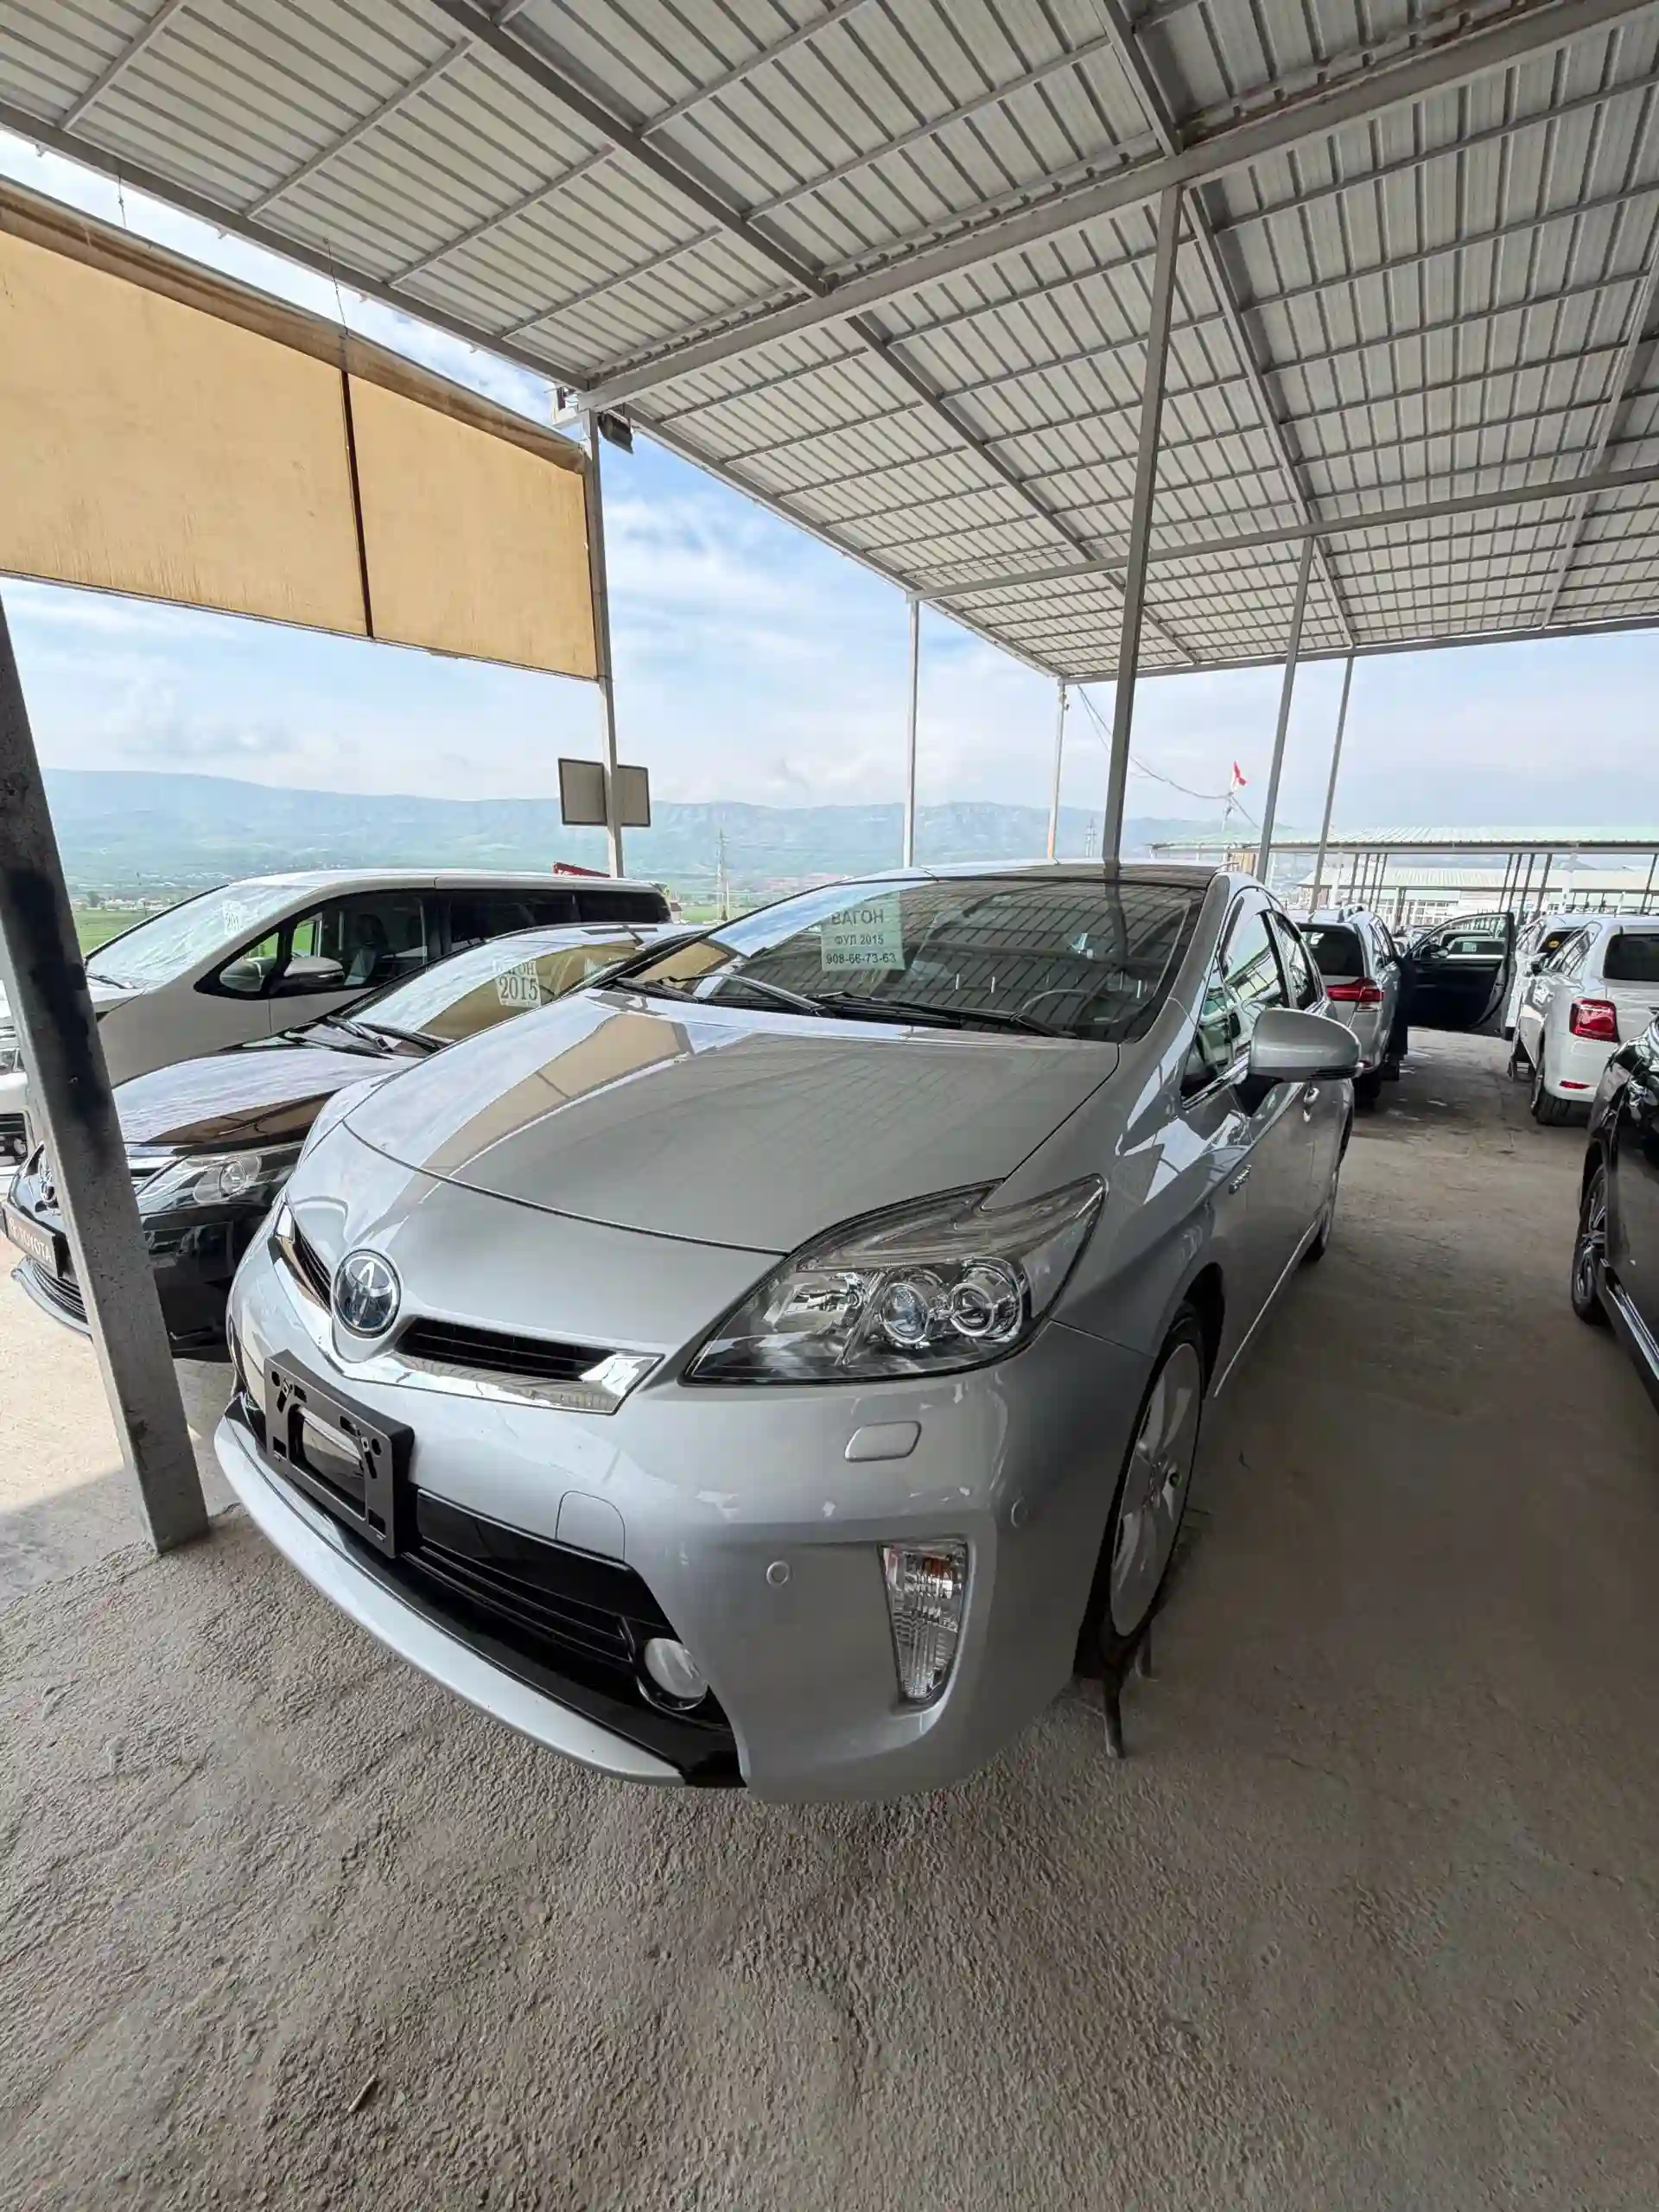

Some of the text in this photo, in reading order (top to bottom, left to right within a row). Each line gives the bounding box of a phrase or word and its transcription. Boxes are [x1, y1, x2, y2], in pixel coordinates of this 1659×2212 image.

[831, 909, 884, 925] ВАГОН
[860, 933, 884, 945] 2015
[499, 976, 538, 1001] 2015
